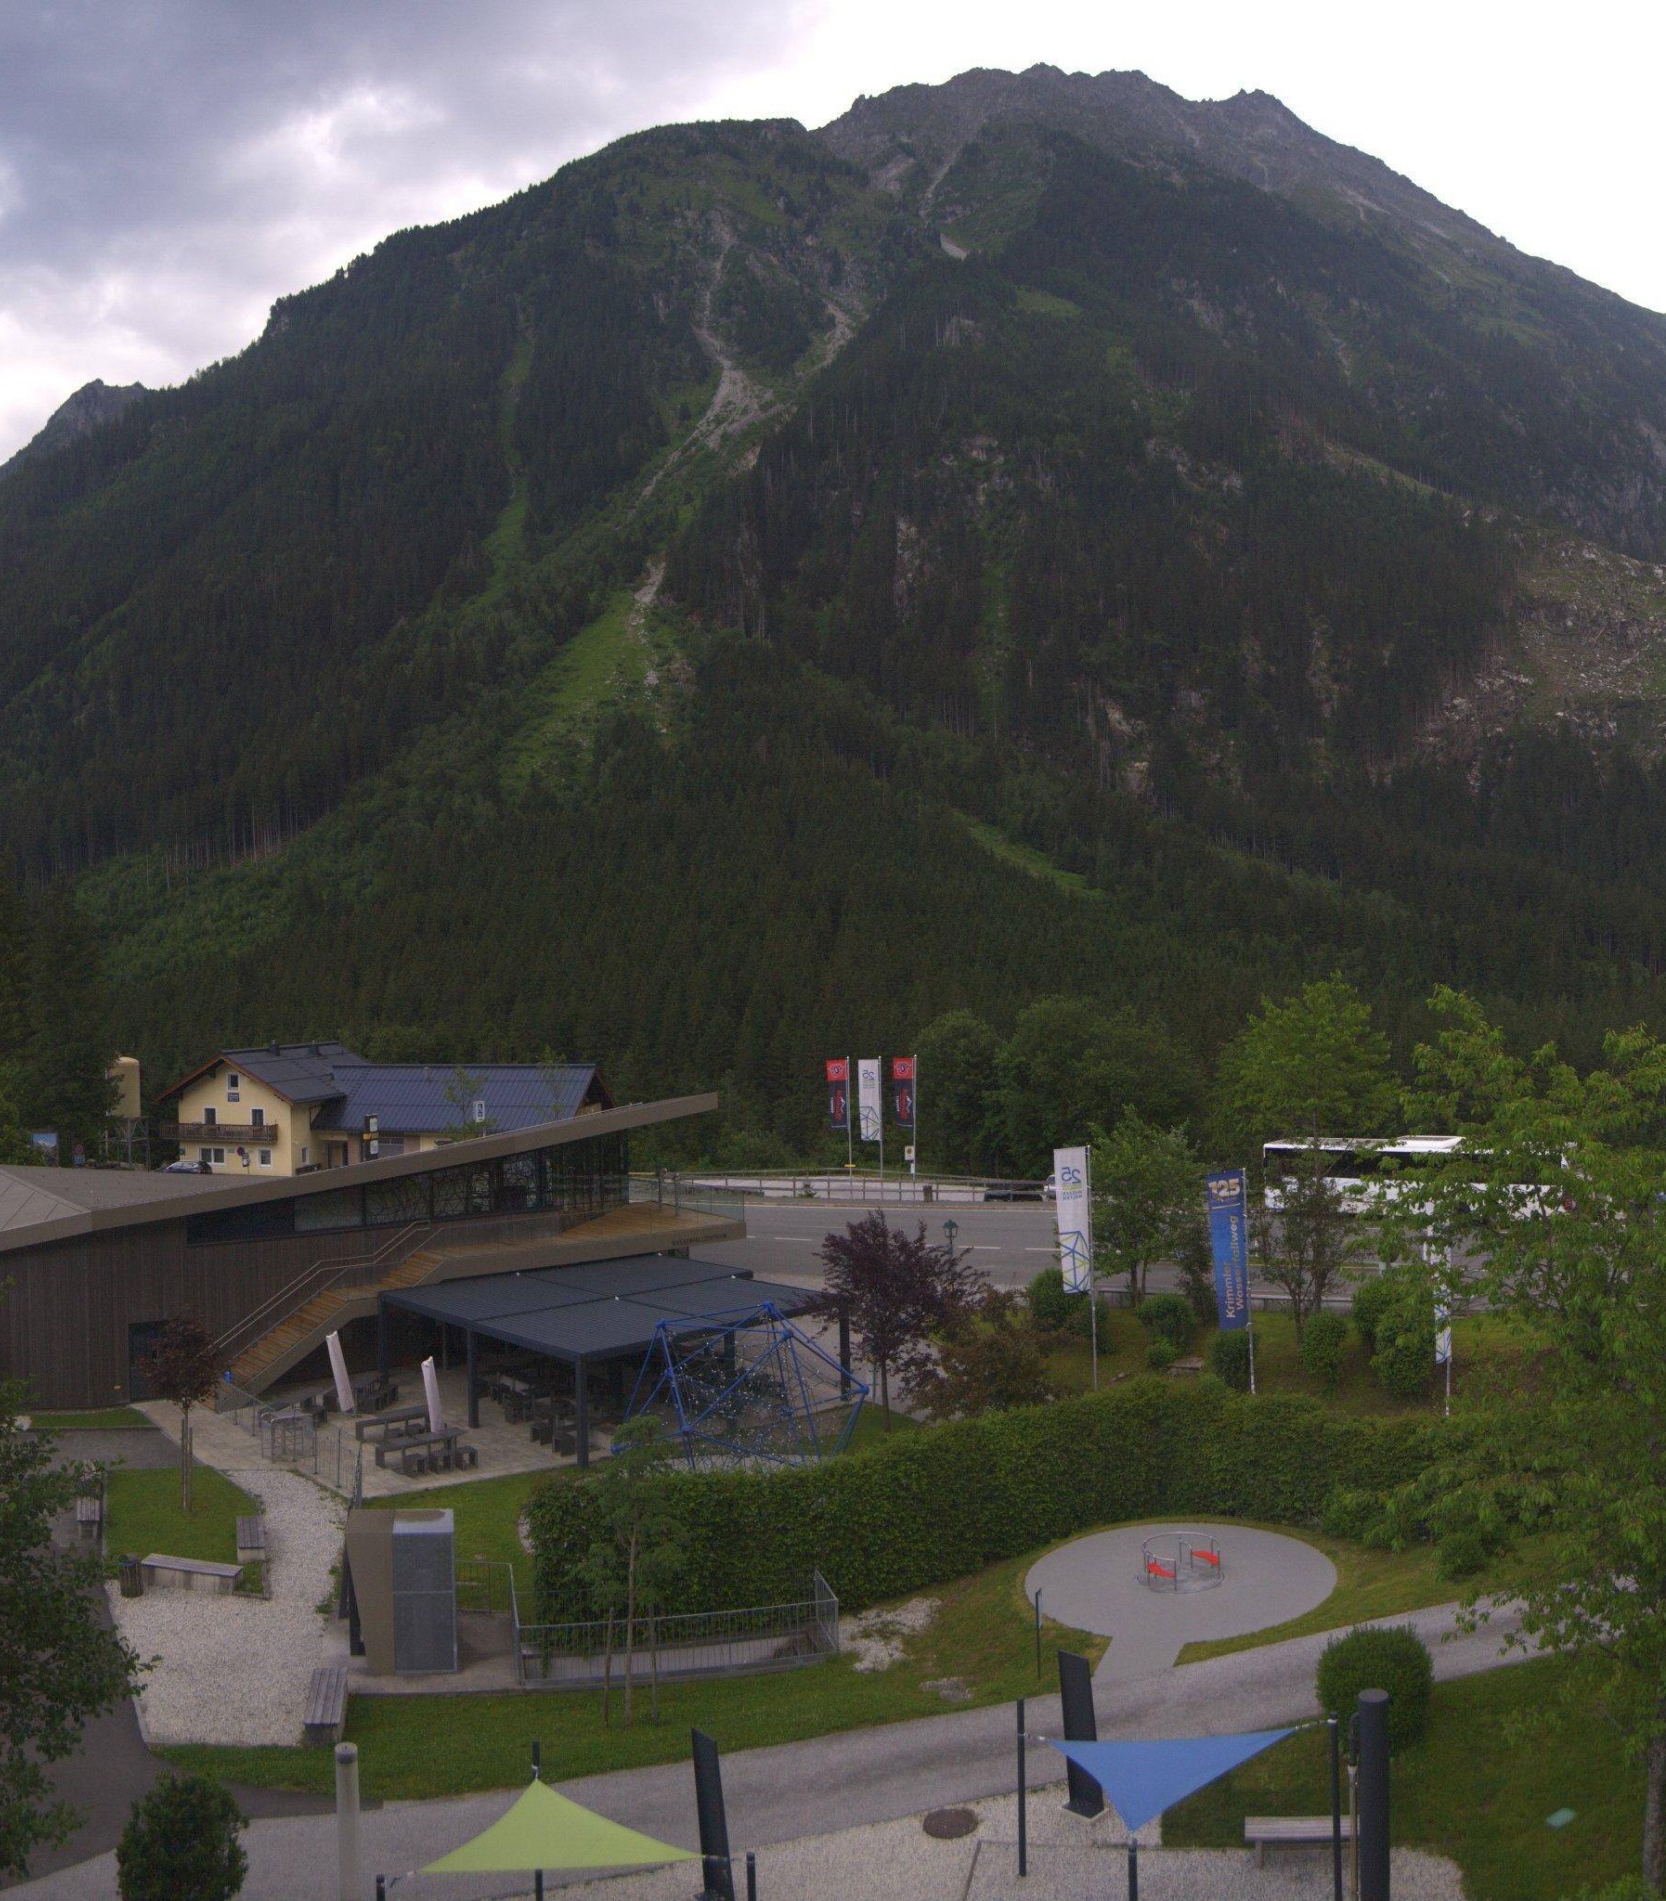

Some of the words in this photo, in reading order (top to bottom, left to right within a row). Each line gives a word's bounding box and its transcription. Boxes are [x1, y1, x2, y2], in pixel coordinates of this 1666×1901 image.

[1208, 1178, 1240, 1197] 125
[1222, 1261, 1236, 1318] Krimmler
[1229, 1215, 1245, 1310] Wasserfallweg
